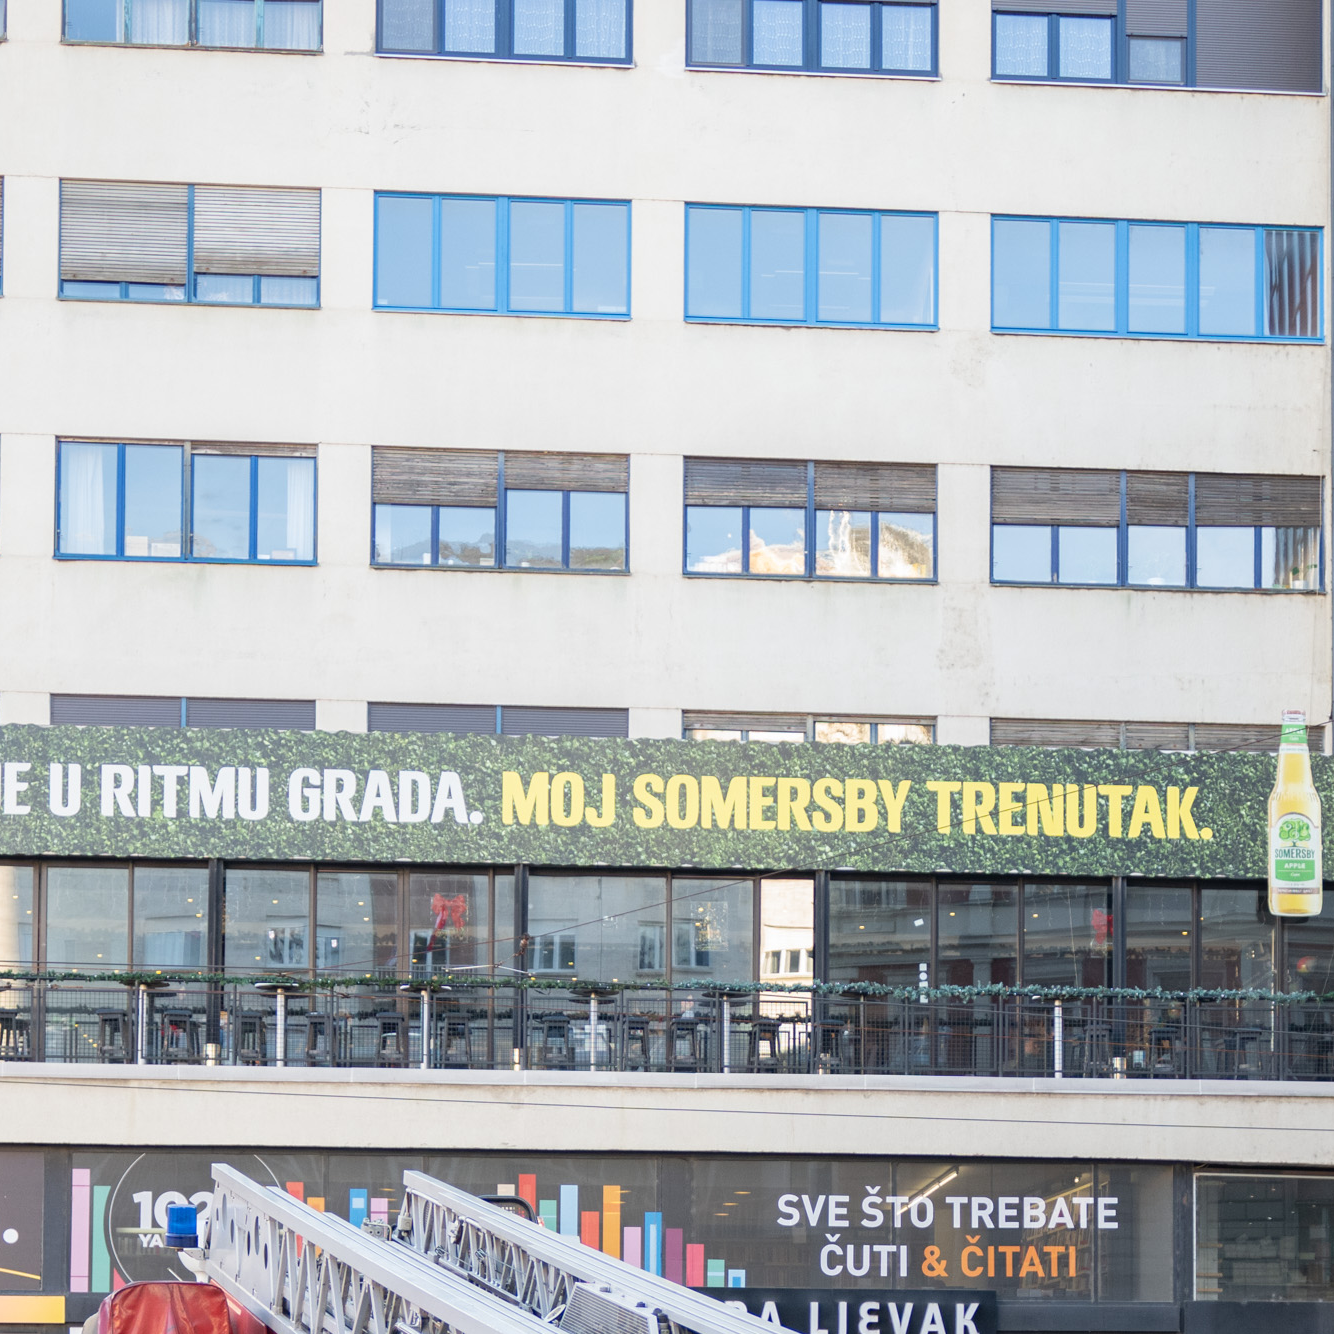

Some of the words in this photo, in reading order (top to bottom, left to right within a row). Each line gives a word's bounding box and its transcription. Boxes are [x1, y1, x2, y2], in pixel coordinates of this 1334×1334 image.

[49, 762, 81, 816] U
[100, 764, 269, 820] RITMU
[288, 768, 484, 825] GRADA.
[501, 770, 616, 828] MOJ
[632, 773, 912, 833] SOMERSBY
[926, 781, 1214, 839] TRENUTAK.
[1274, 848, 1315, 858] SOMERSBY
[776, 1194, 849, 1229] SVE
[861, 1185, 934, 1229] ŠTO
[946, 1196, 1119, 1229] TREBATE
[820, 1233, 908, 1277] ČUTI
[921, 1245, 948, 1277] &
[960, 1235, 1077, 1278] ČITATI
